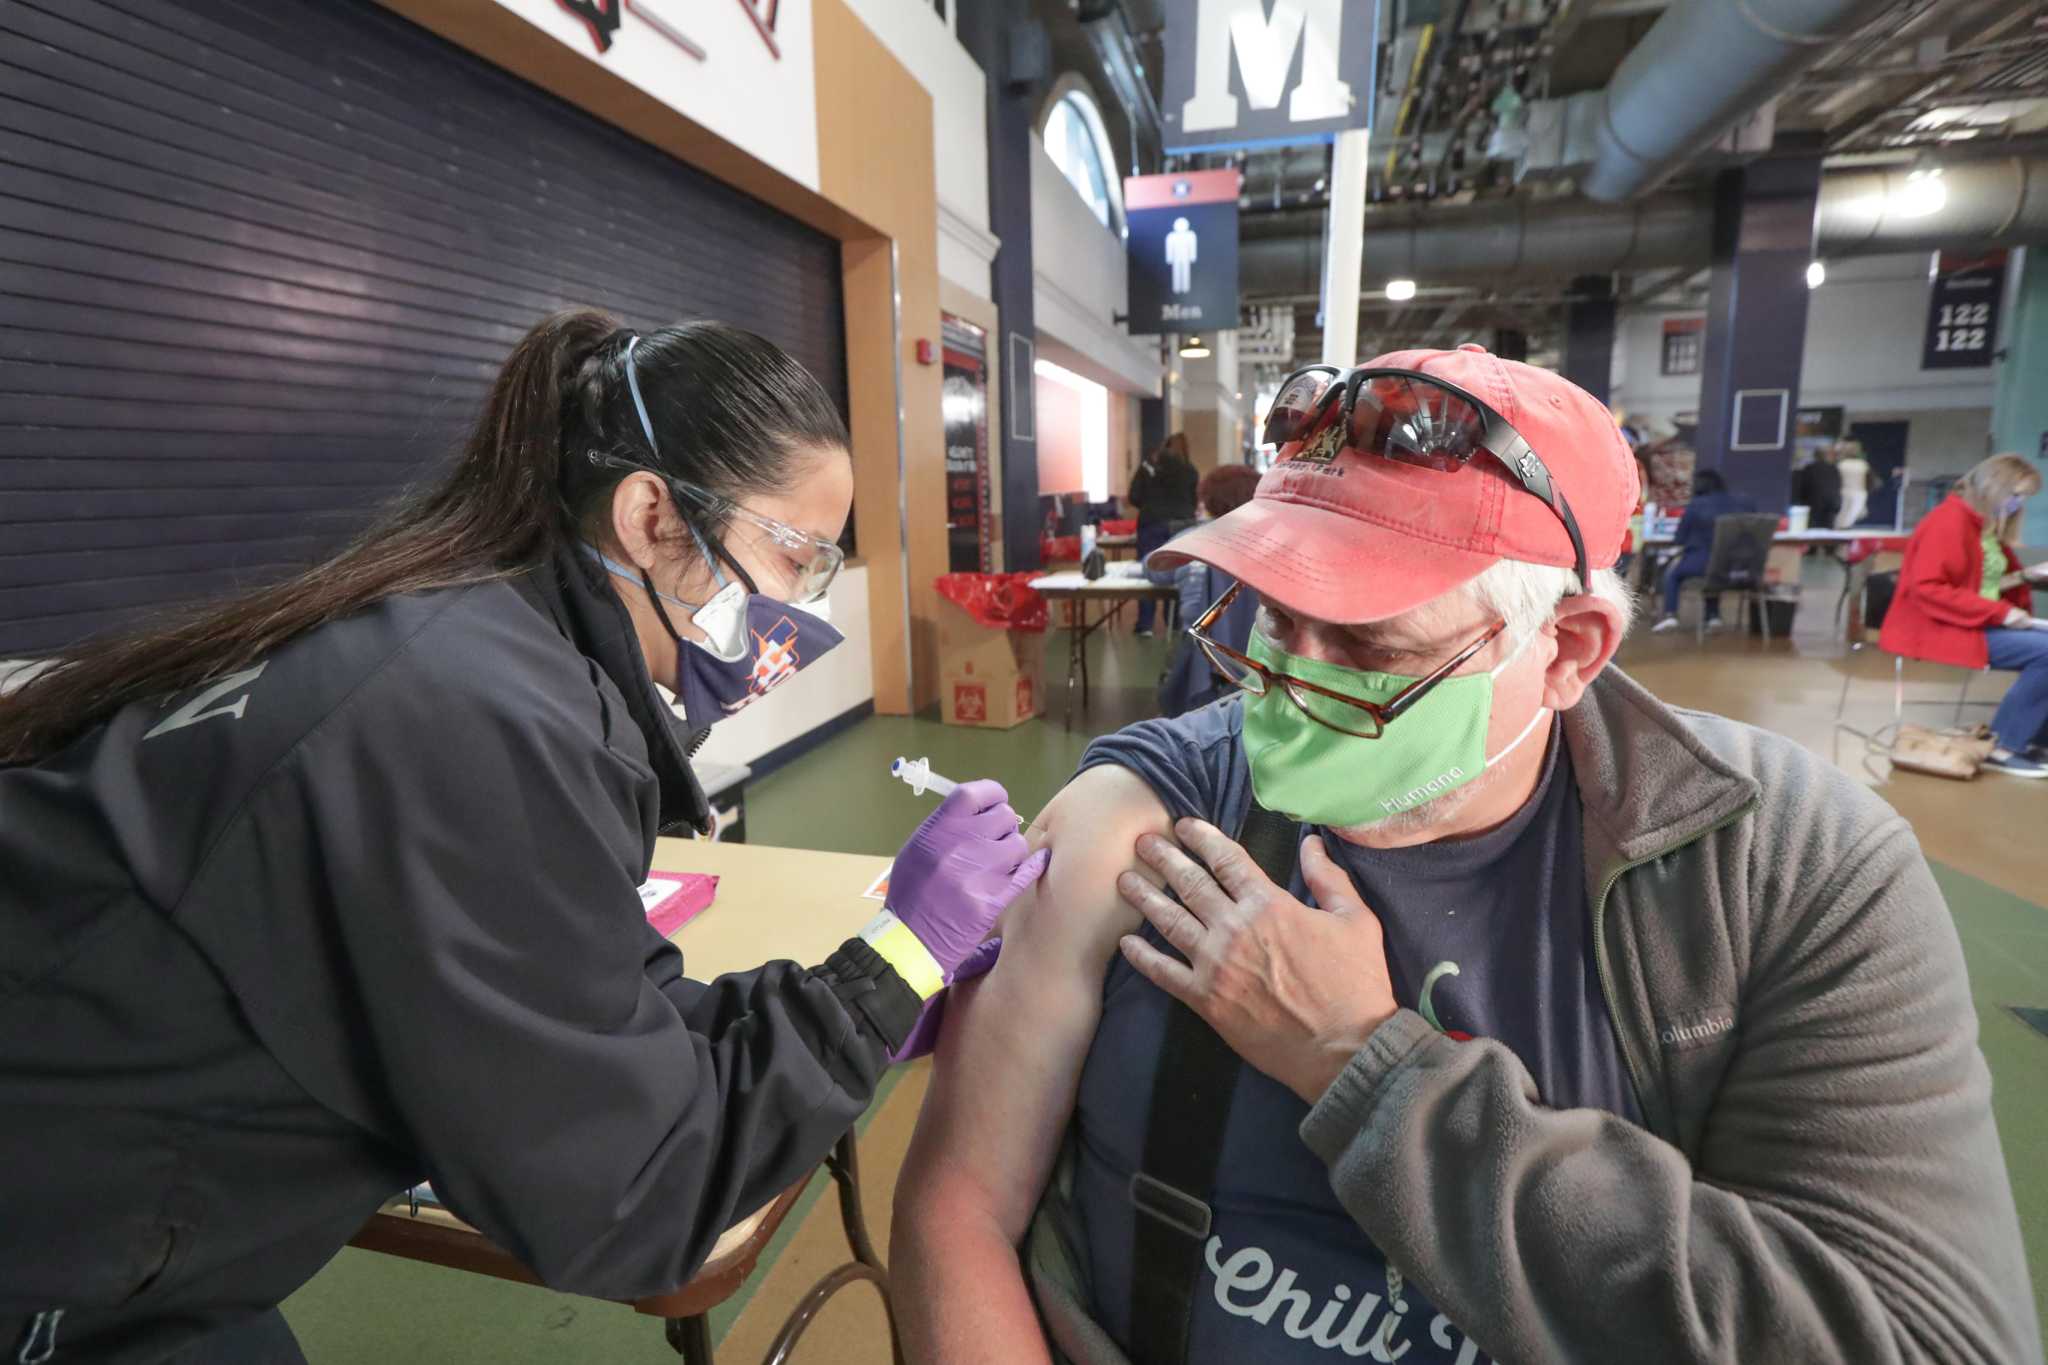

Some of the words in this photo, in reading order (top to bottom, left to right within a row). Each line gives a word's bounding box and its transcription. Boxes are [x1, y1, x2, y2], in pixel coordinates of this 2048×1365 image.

[1183, 0, 1352, 131] M
[1161, 304, 1203, 320] Men
[1939, 303, 1990, 327] 122
[1935, 328, 1986, 352] 122
[1378, 766, 1465, 813] Humana
[1662, 1015, 1735, 1044] olumbia
[1204, 1234, 1412, 1364] Chili
